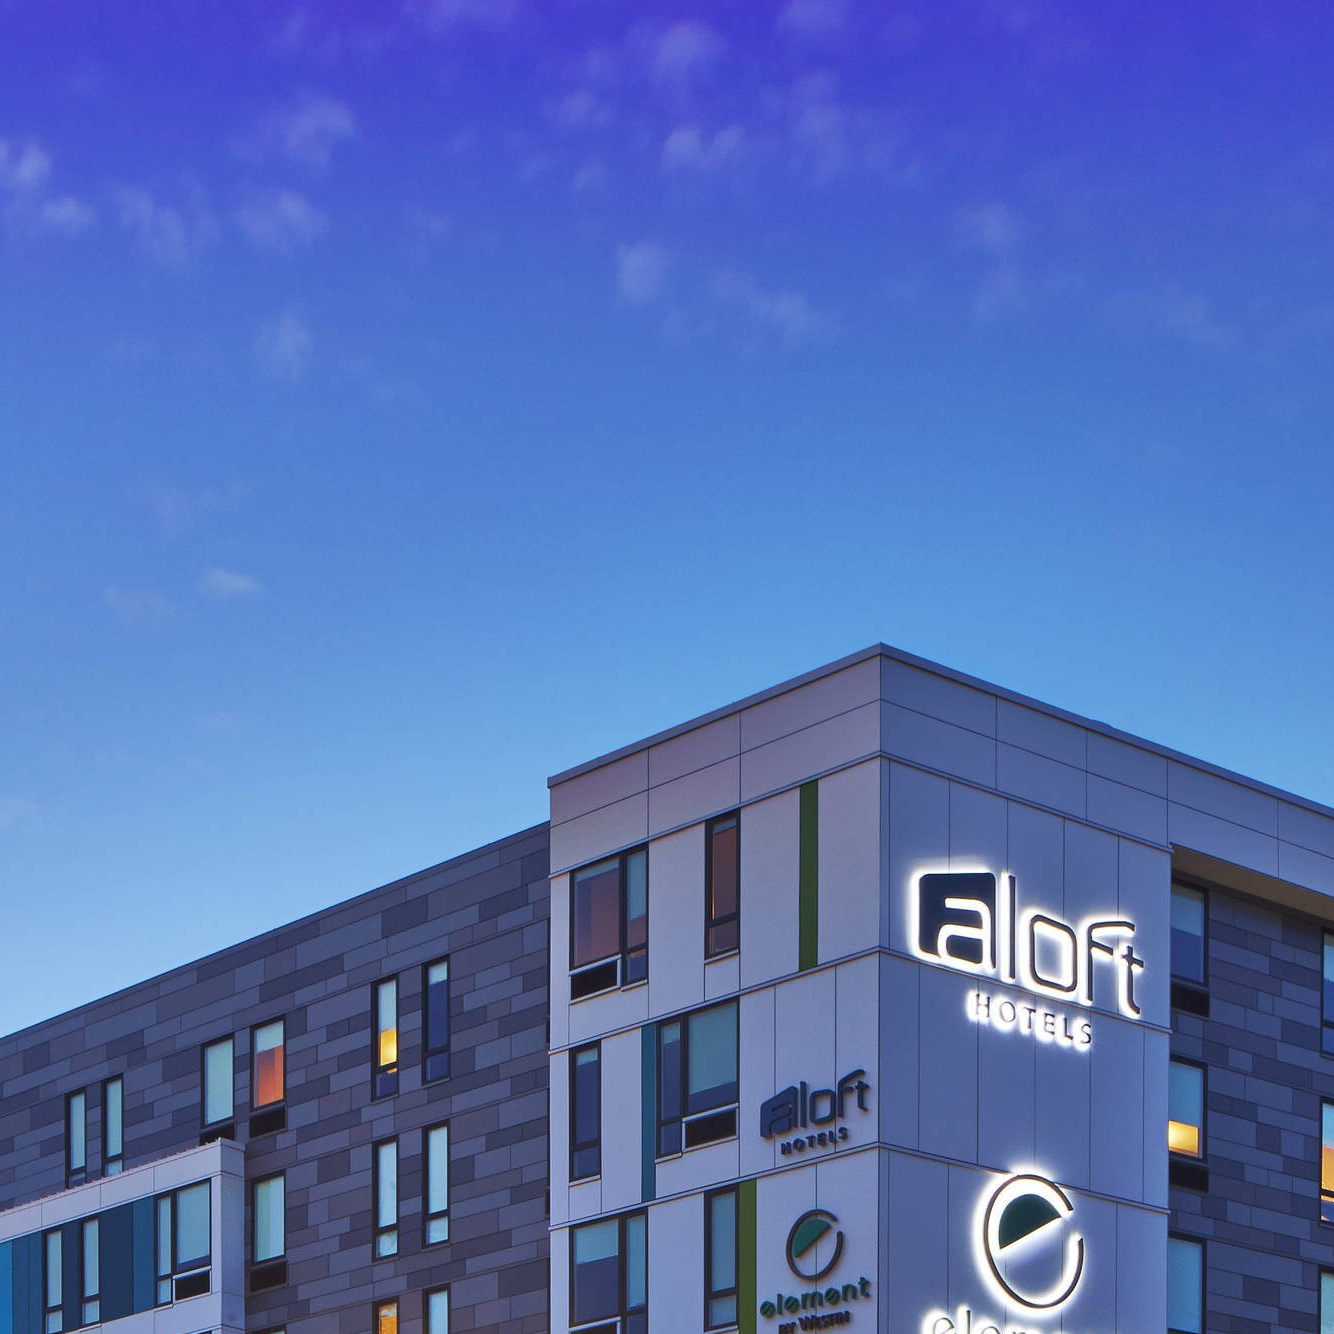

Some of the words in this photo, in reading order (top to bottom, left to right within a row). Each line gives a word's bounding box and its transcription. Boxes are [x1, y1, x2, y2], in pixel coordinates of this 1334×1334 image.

[913, 868, 1145, 1018] aloft
[971, 990, 1093, 1049] HOTELS
[760, 1068, 870, 1139] aloft
[780, 1126, 849, 1156] HOTELS
[759, 1276, 870, 1319] element
